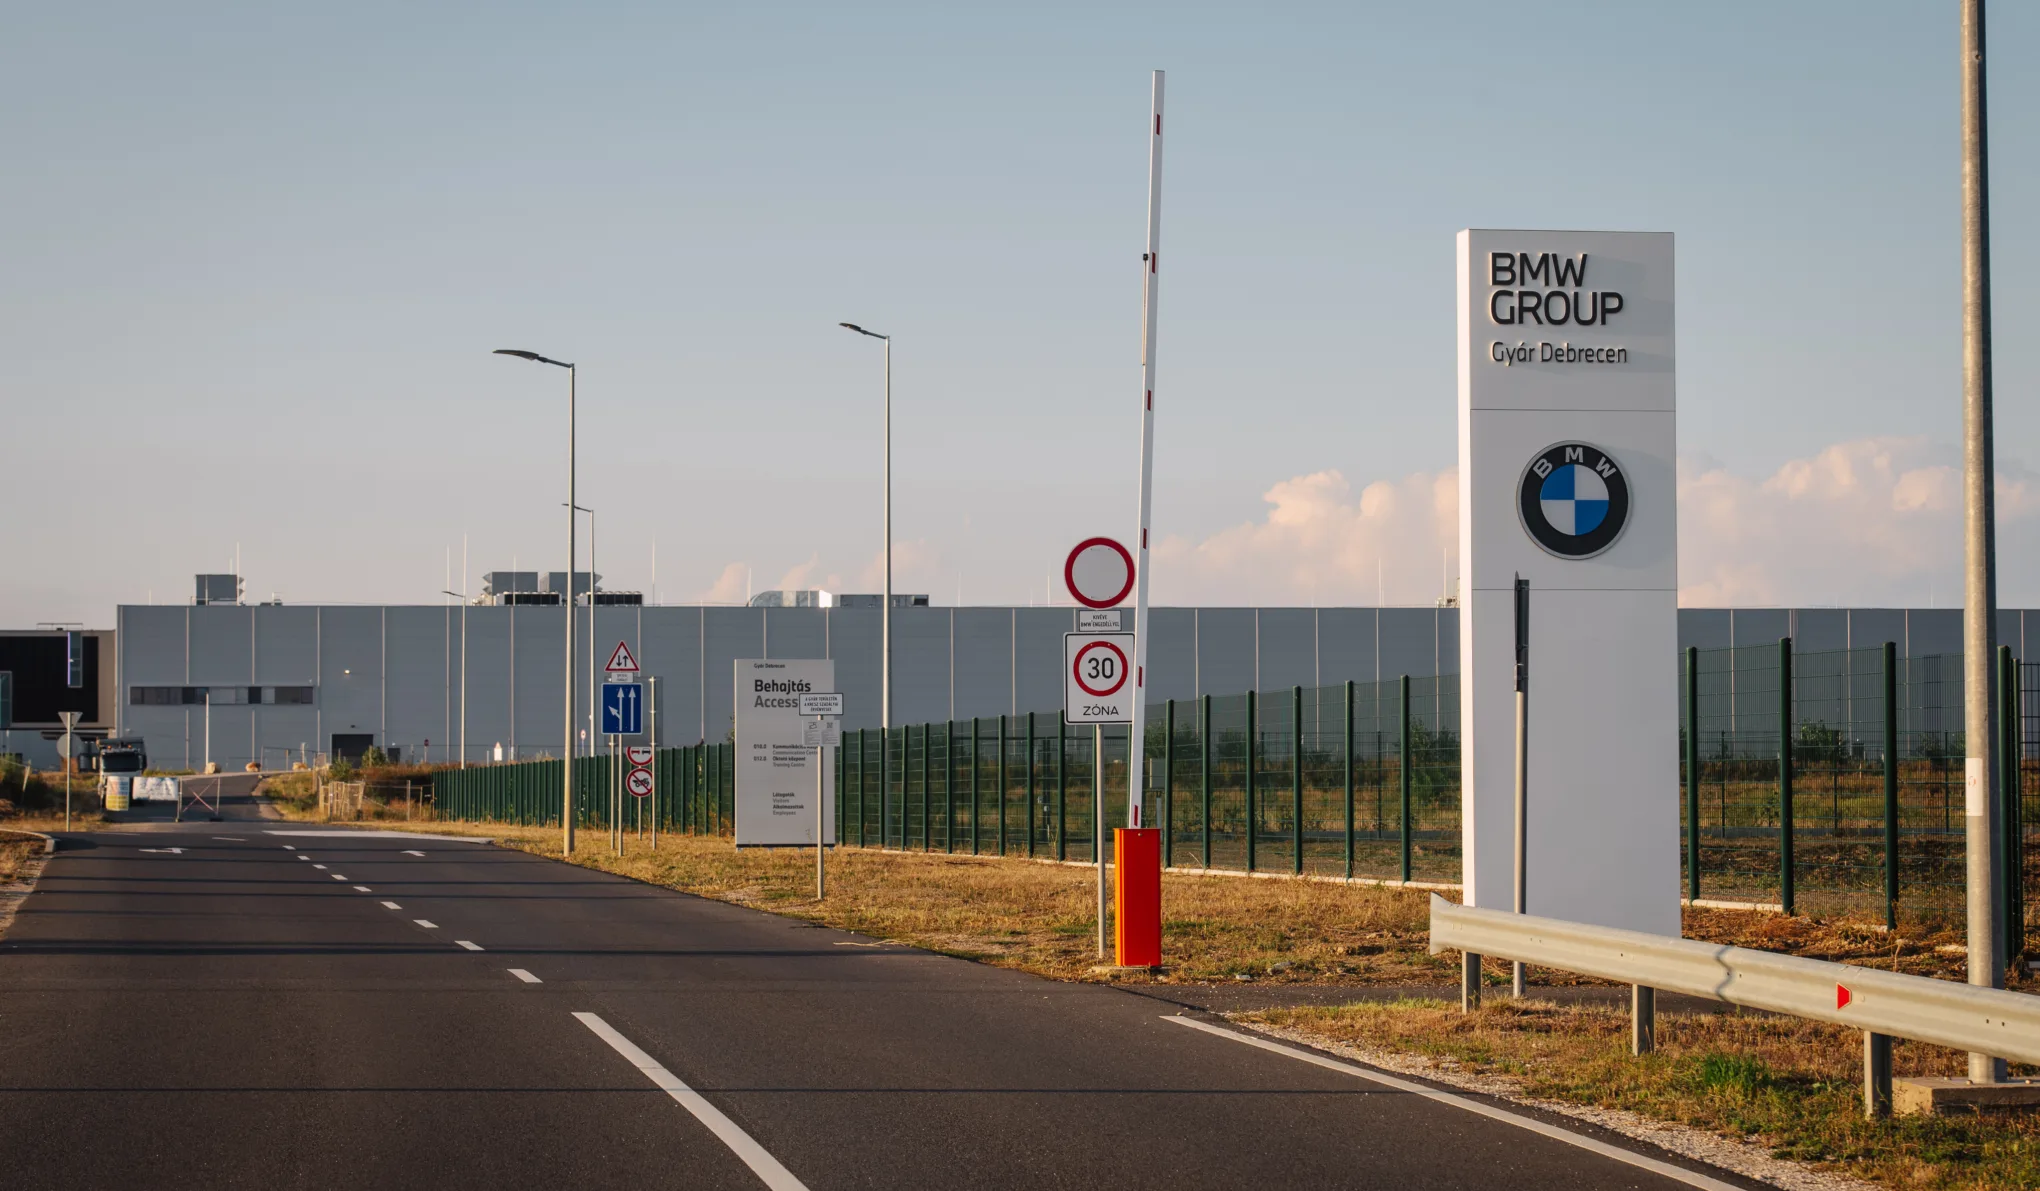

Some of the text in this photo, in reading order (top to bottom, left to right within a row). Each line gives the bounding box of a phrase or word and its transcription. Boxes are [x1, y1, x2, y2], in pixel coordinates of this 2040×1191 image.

[1490, 252, 1588, 287] BMW
[1490, 290, 1624, 325] GROUP
[1491, 341, 1627, 367] Gyár Debrecen
[1533, 447, 1617, 479] BMW
[1087, 657, 1114, 680] 30
[754, 679, 811, 695] Behajtás
[754, 695, 799, 708] Access
[1083, 703, 1119, 716] ZÓNA
